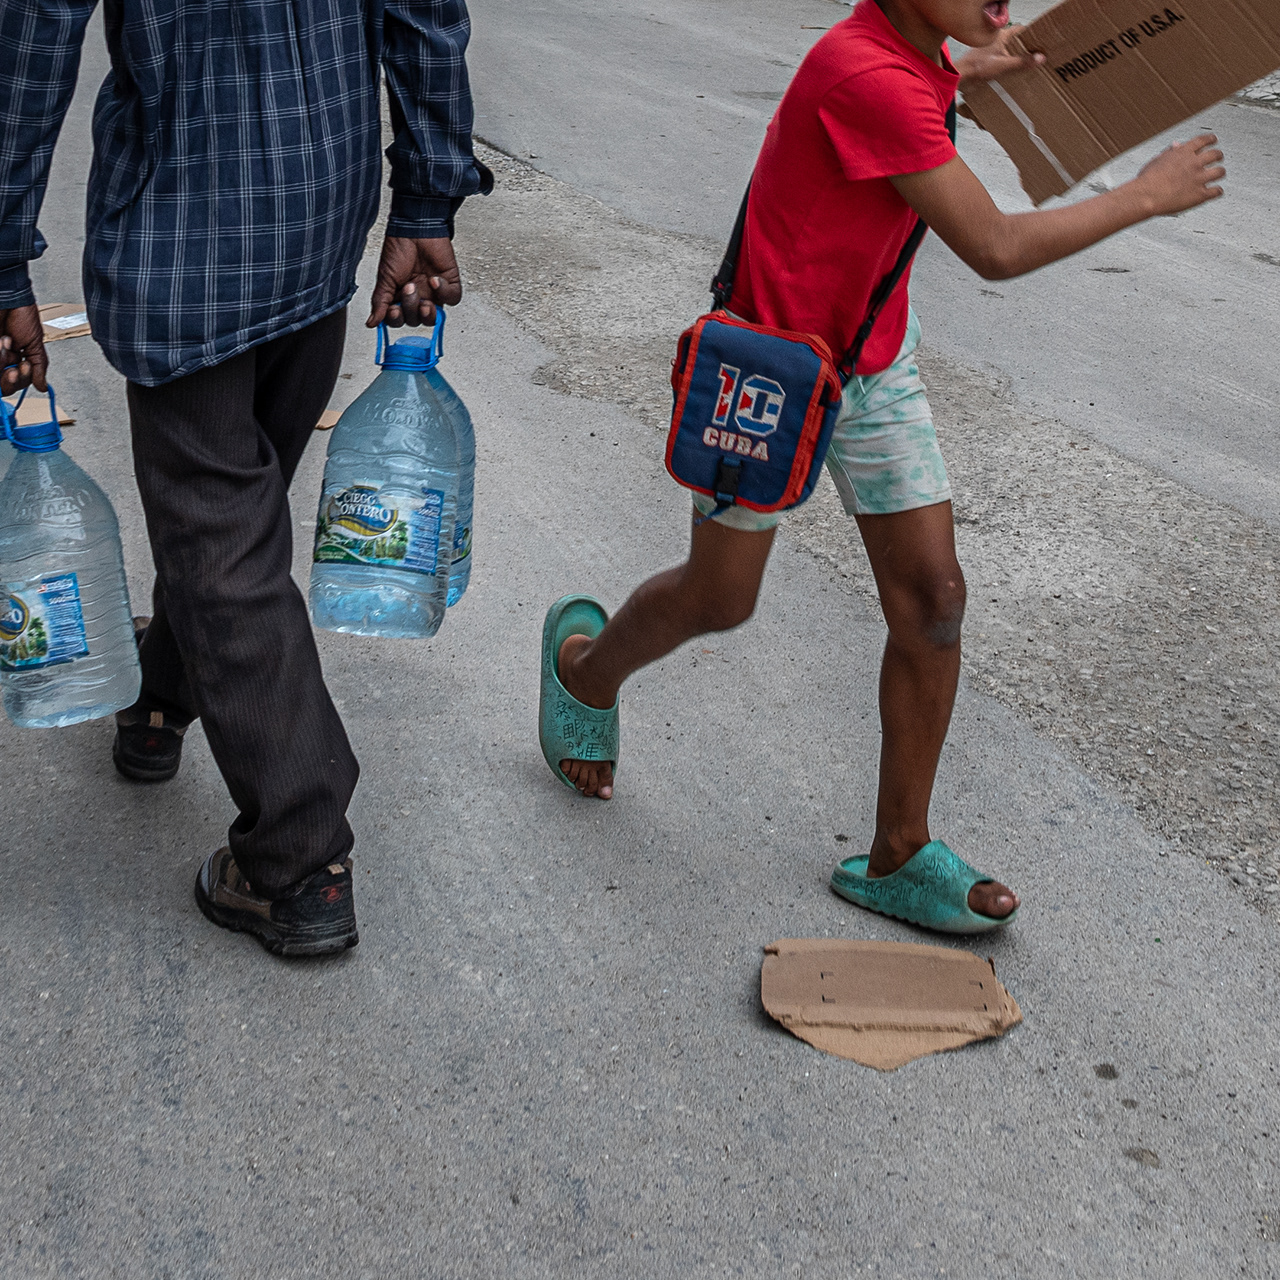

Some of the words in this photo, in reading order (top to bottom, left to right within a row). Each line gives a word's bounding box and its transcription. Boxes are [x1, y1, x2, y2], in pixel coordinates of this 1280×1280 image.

[1054, 39, 1123, 83] PRODUCT
[1118, 27, 1142, 48] OF
[1138, 8, 1185, 37] U.S.A.
[711, 362, 786, 437] 10
[702, 426, 769, 462] CUBA
[336, 502, 392, 523] ONTERO
